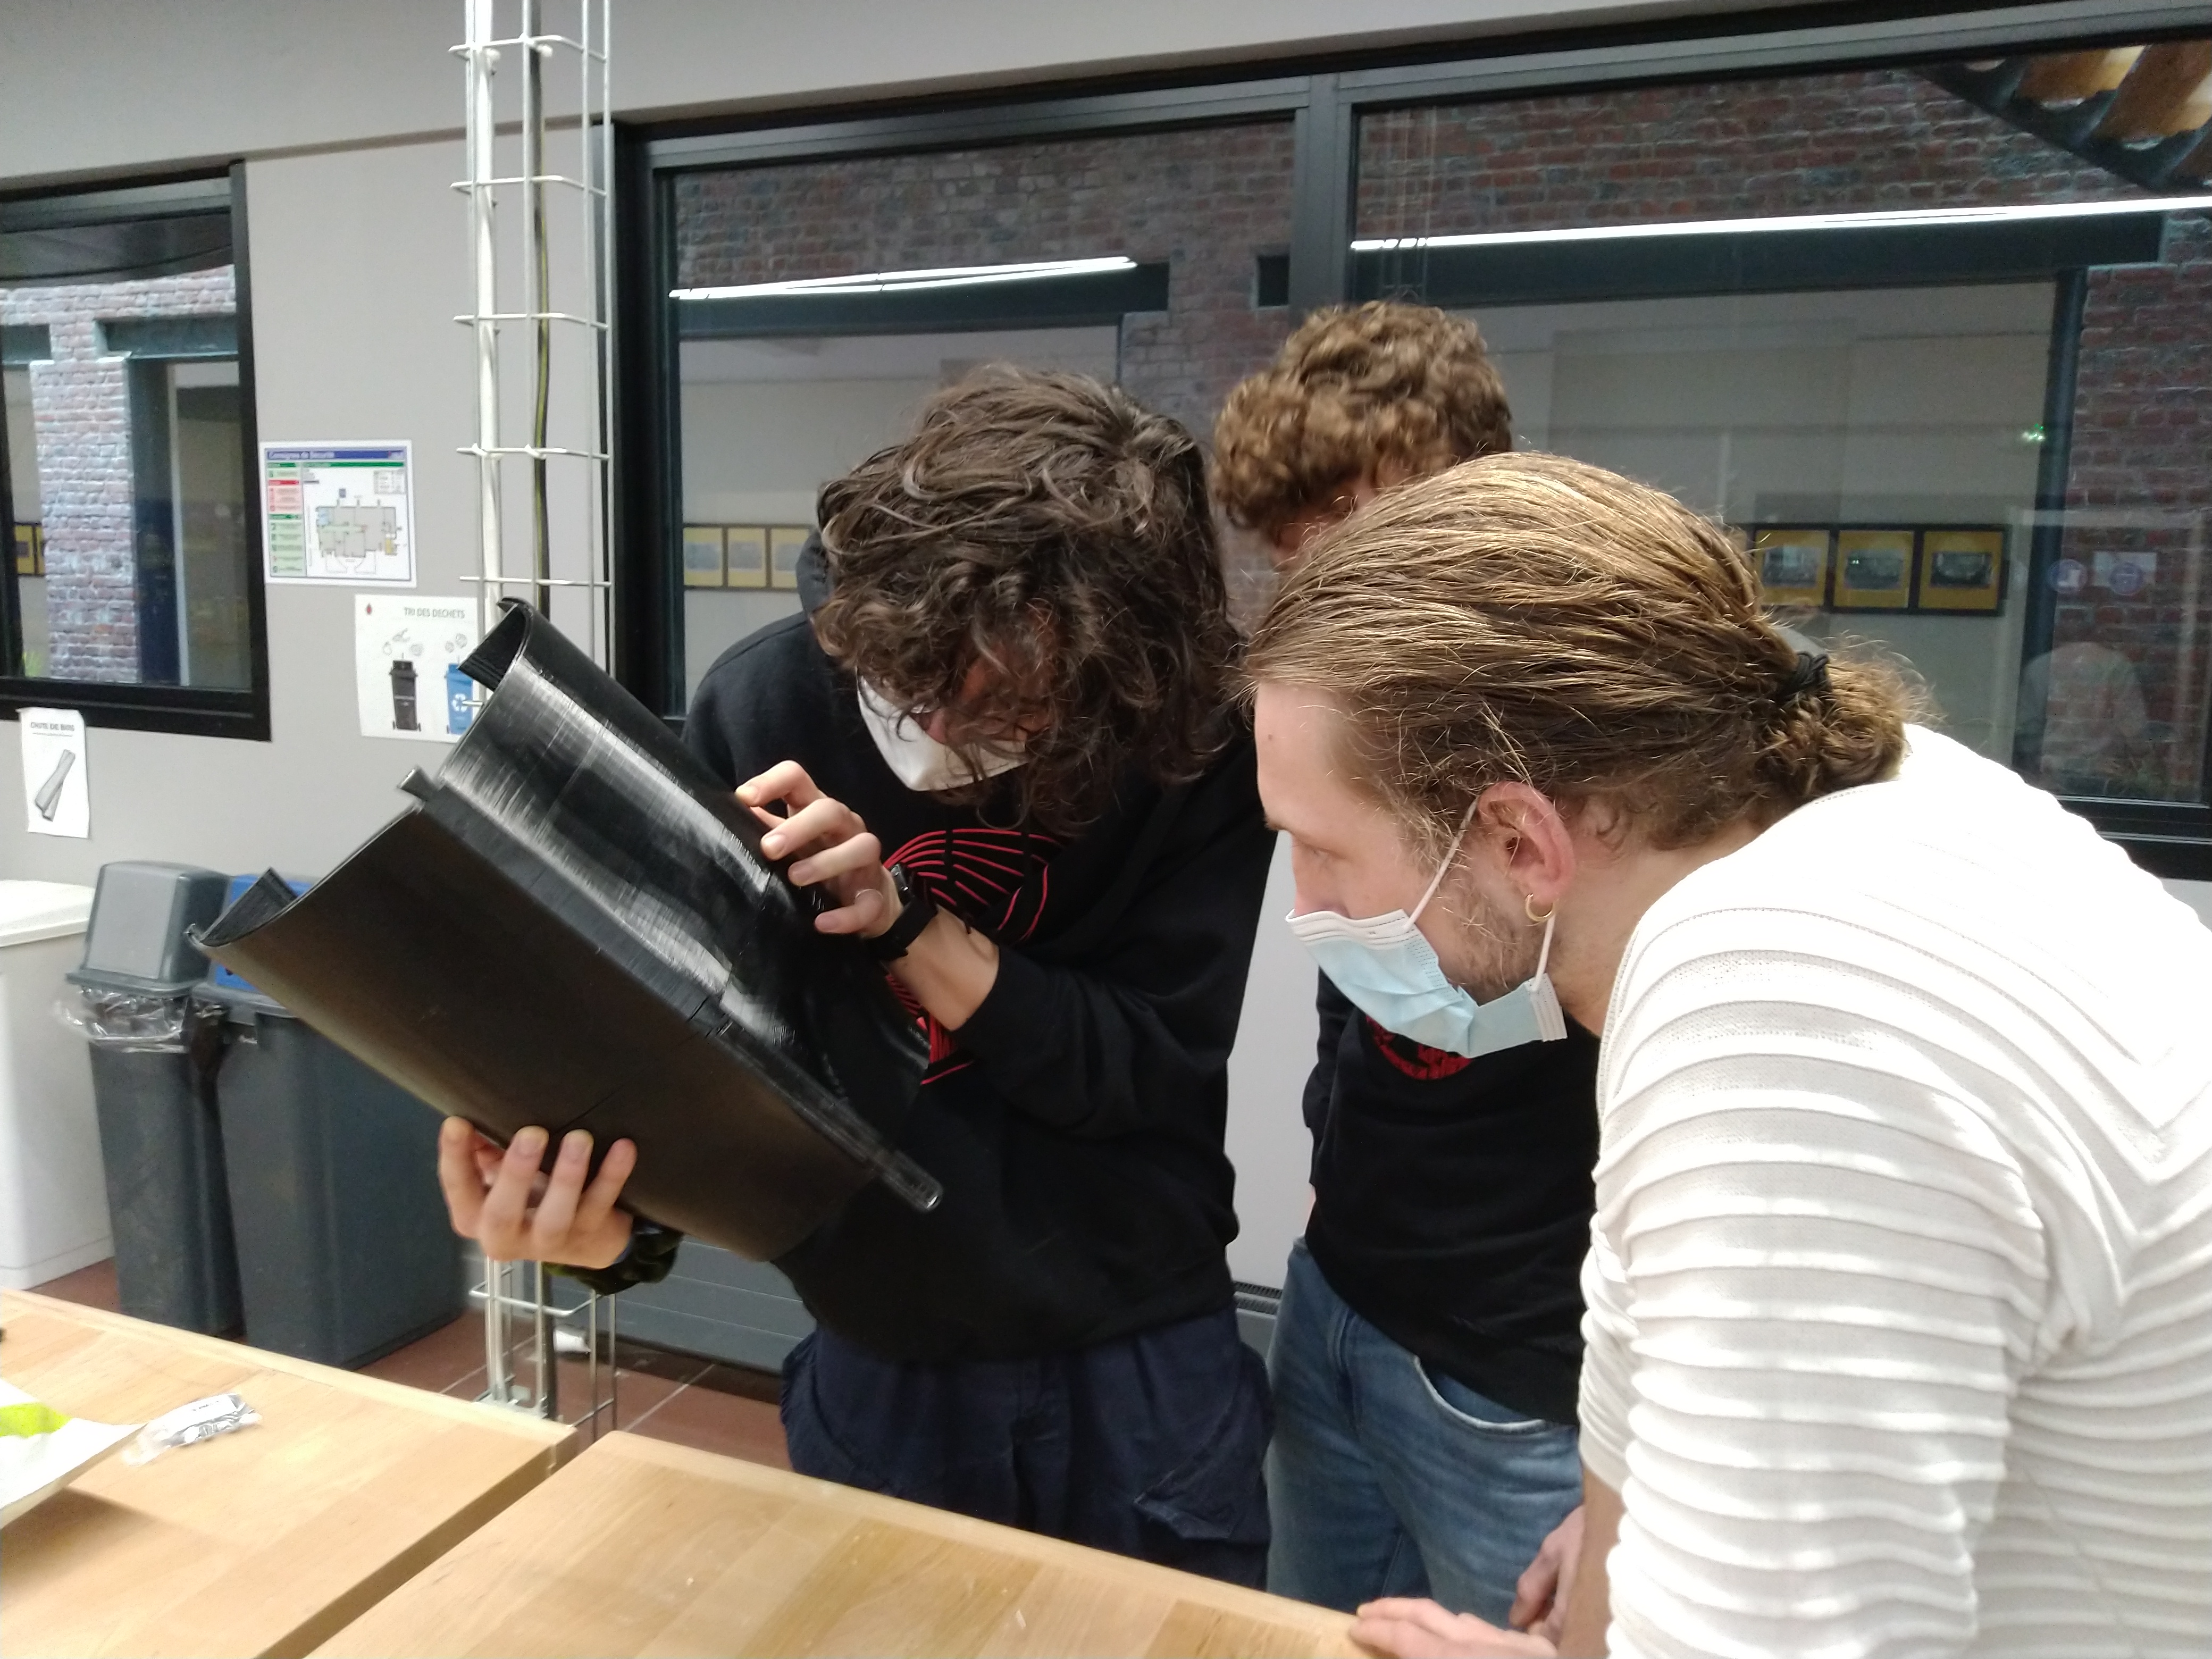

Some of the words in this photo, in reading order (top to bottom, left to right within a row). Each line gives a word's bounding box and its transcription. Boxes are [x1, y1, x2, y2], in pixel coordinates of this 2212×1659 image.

[404, 607, 415, 616] TRI
[417, 608, 430, 617] DES
[432, 609, 465, 619] DECHETS
